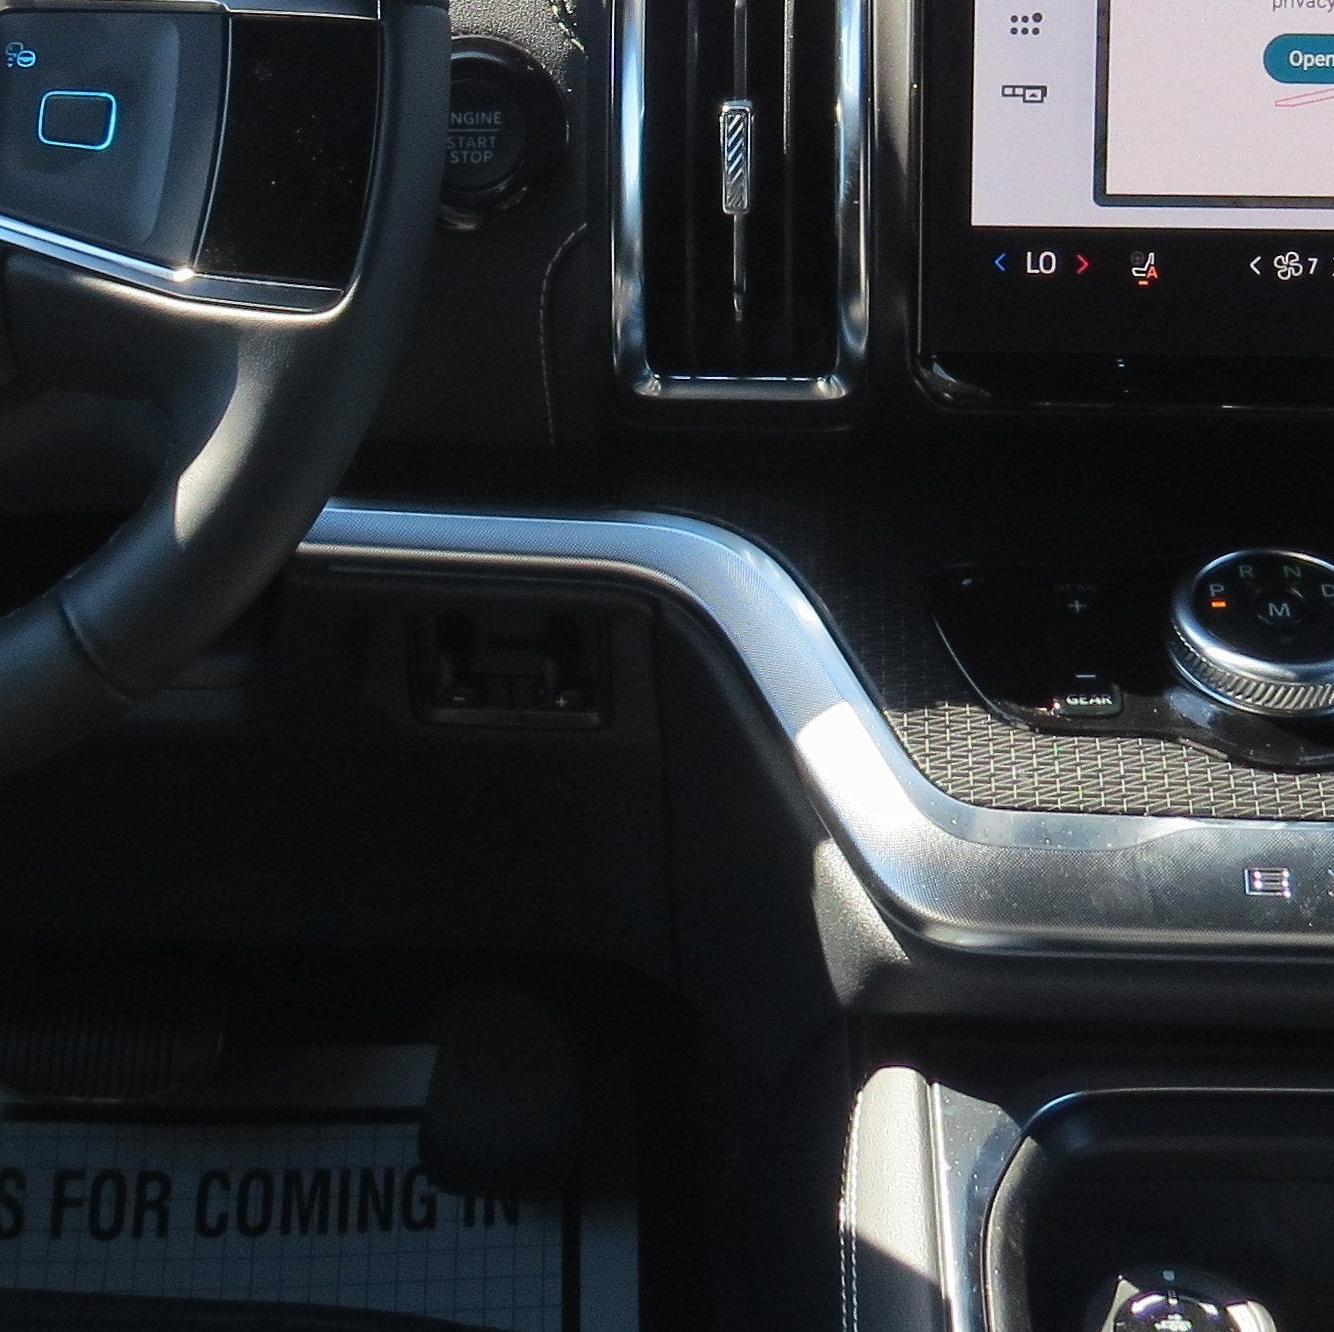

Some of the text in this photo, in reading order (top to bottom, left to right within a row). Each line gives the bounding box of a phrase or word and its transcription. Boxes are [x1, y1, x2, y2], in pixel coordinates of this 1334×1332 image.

[448, 110, 503, 126] NGINE
[446, 135, 497, 150] START
[450, 150, 495, 165] STOP
[1025, 250, 1058, 276] LO
[1307, 256, 1319, 276] 7
[1238, 564, 1255, 579] R
[1282, 564, 1303, 579] N
[1208, 582, 1225, 598] P
[1267, 602, 1292, 617] M
[1064, 693, 1114, 707] GEAR
[49, 1165, 175, 1243] FOR
[193, 1162, 441, 1240] COMING
